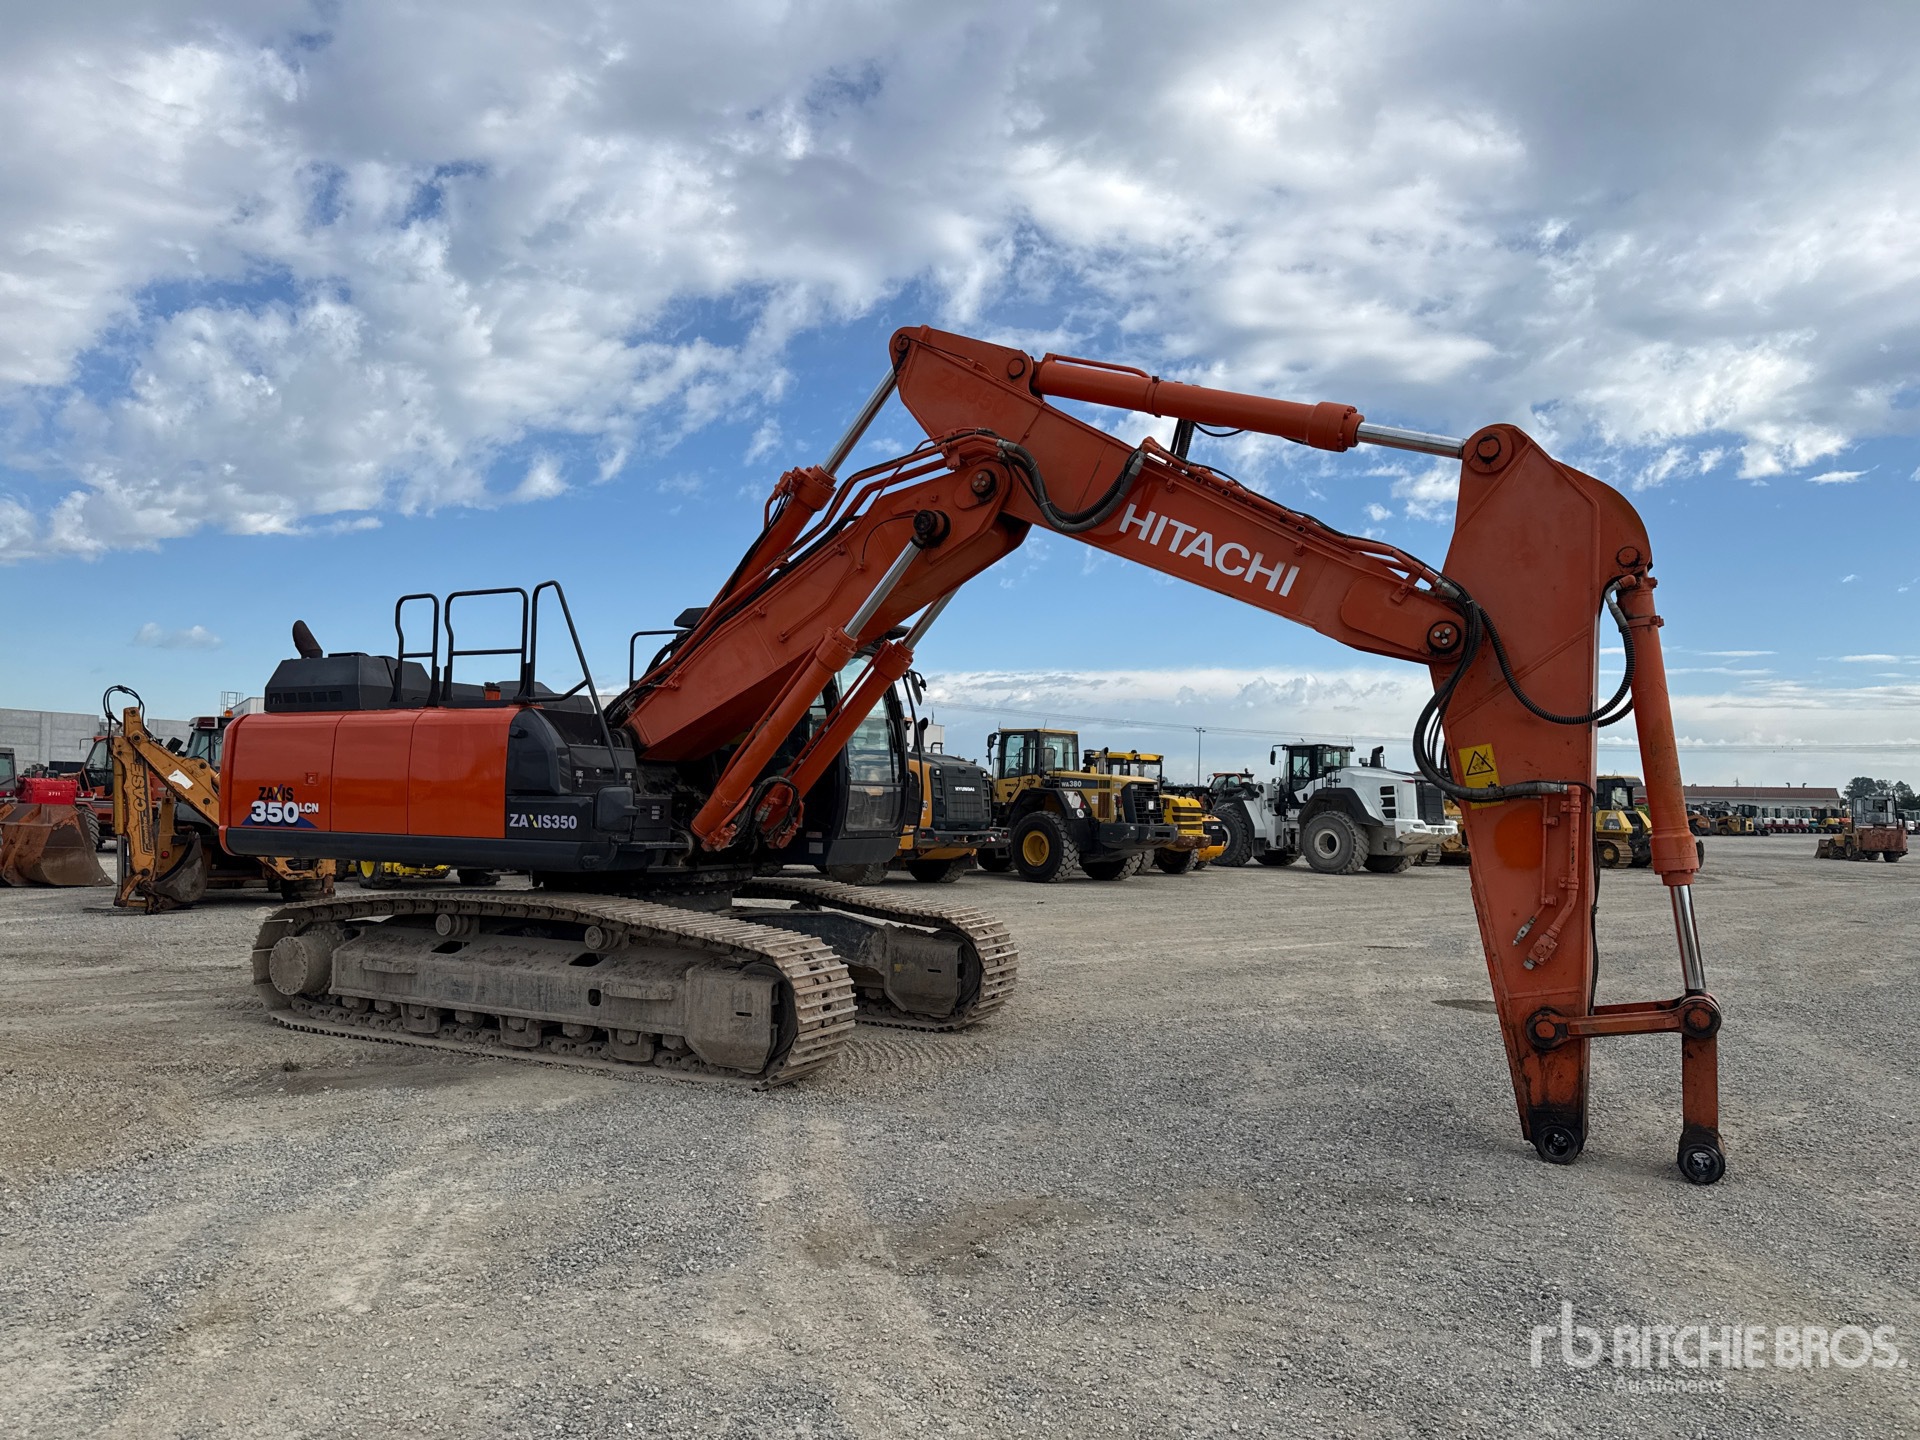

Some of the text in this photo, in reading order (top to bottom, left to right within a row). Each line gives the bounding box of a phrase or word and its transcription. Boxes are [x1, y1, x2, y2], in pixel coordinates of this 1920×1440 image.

[1118, 503, 1300, 598] HITACHI
[131, 764, 147, 811] CASE
[258, 784, 294, 801] ZAXIS
[1061, 780, 1082, 788] WA380
